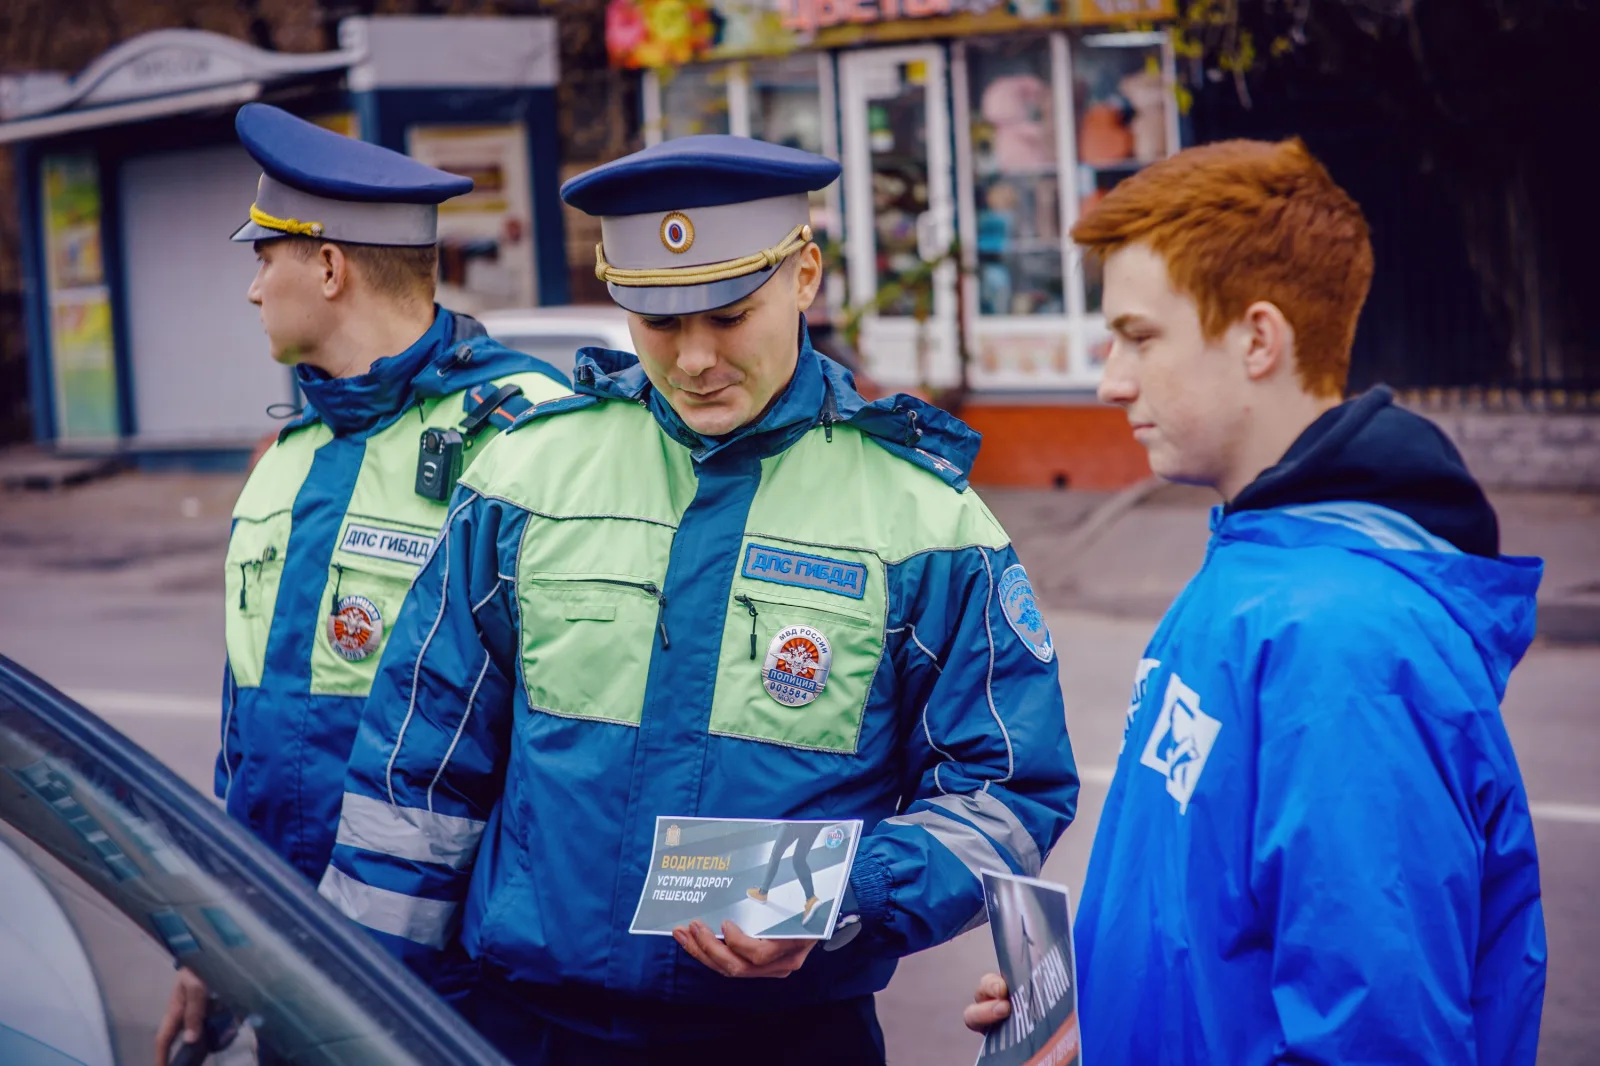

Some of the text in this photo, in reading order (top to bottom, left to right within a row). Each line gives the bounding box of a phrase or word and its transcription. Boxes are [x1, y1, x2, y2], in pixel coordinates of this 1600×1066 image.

[346, 530, 430, 558] ДПС ГИБДД
[752, 552, 858, 589] ДПС ГИБДД
[778, 628, 828, 654] МВД РОССИИ
[770, 670, 816, 691] ПОЛИЦИЯ
[769, 681, 808, 701] 003584
[661, 855, 730, 872] ВОДИТЕЛЬ!
[656, 875, 733, 889] УСТУПИ ДОРОГУ
[652, 889, 707, 903] ПЕШЕХОДУ
